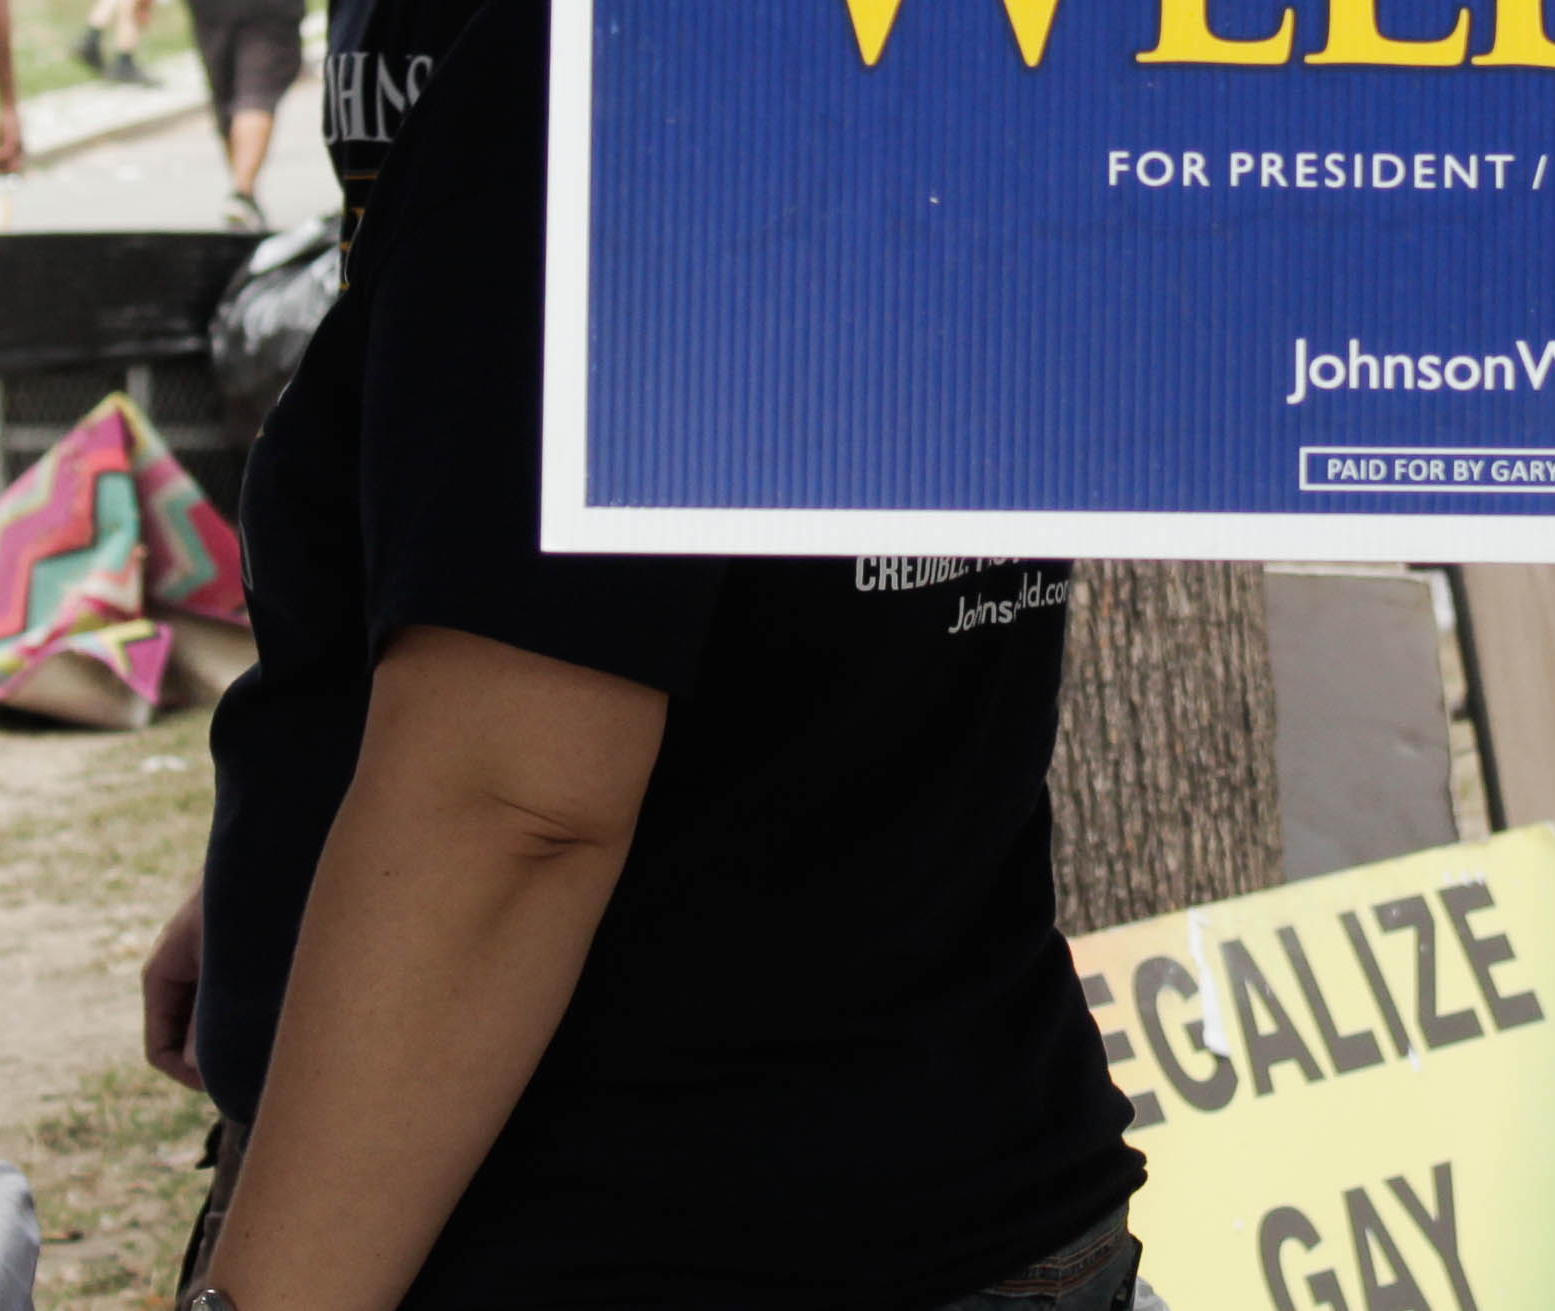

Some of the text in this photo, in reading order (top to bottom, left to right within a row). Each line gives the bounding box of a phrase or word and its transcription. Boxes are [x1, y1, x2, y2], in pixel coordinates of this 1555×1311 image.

[1108, 150, 1210, 187] FOR
[1230, 151, 1514, 190] PRESIDENT
[1327, 458, 1387, 481] PAID
[1394, 459, 1445, 481] FOR
[1453, 459, 1484, 481] BY
[1257, 1160, 1479, 1311] GAY
